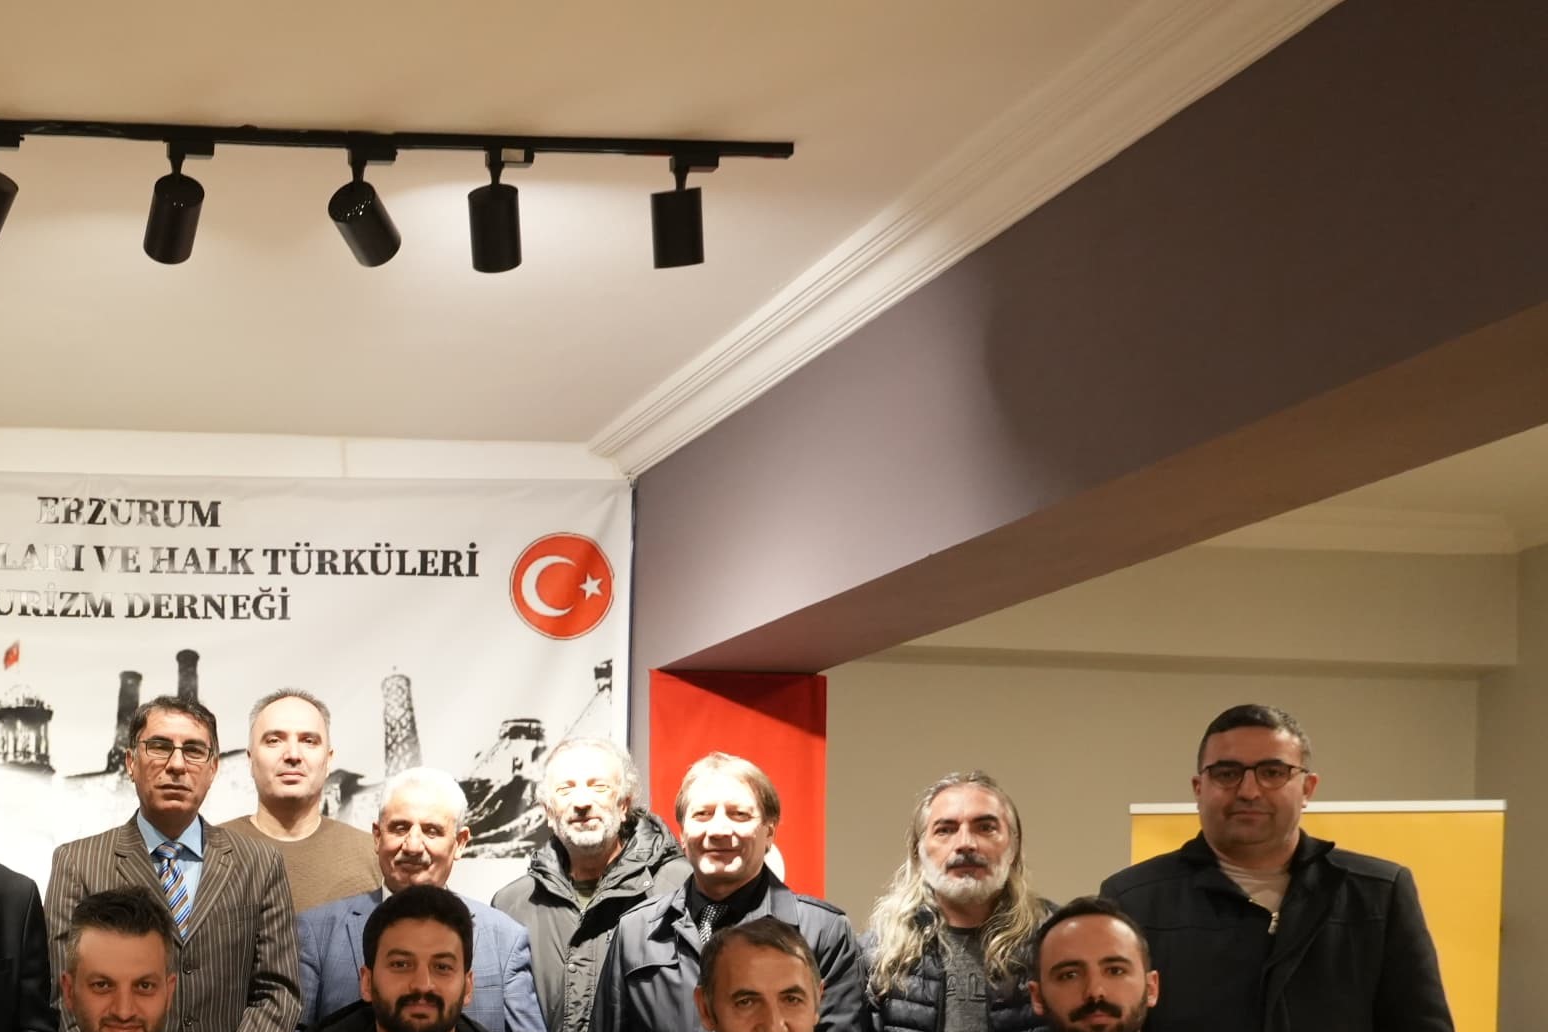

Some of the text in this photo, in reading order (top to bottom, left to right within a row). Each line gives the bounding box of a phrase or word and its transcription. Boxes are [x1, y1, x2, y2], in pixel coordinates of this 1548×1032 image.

[37, 497, 221, 527] ERZURUM
[94, 545, 141, 573] VE
[149, 547, 254, 575] HALK
[263, 542, 479, 577] TÜRKÜLERİ
[125, 586, 290, 620] DERNEĞİ
